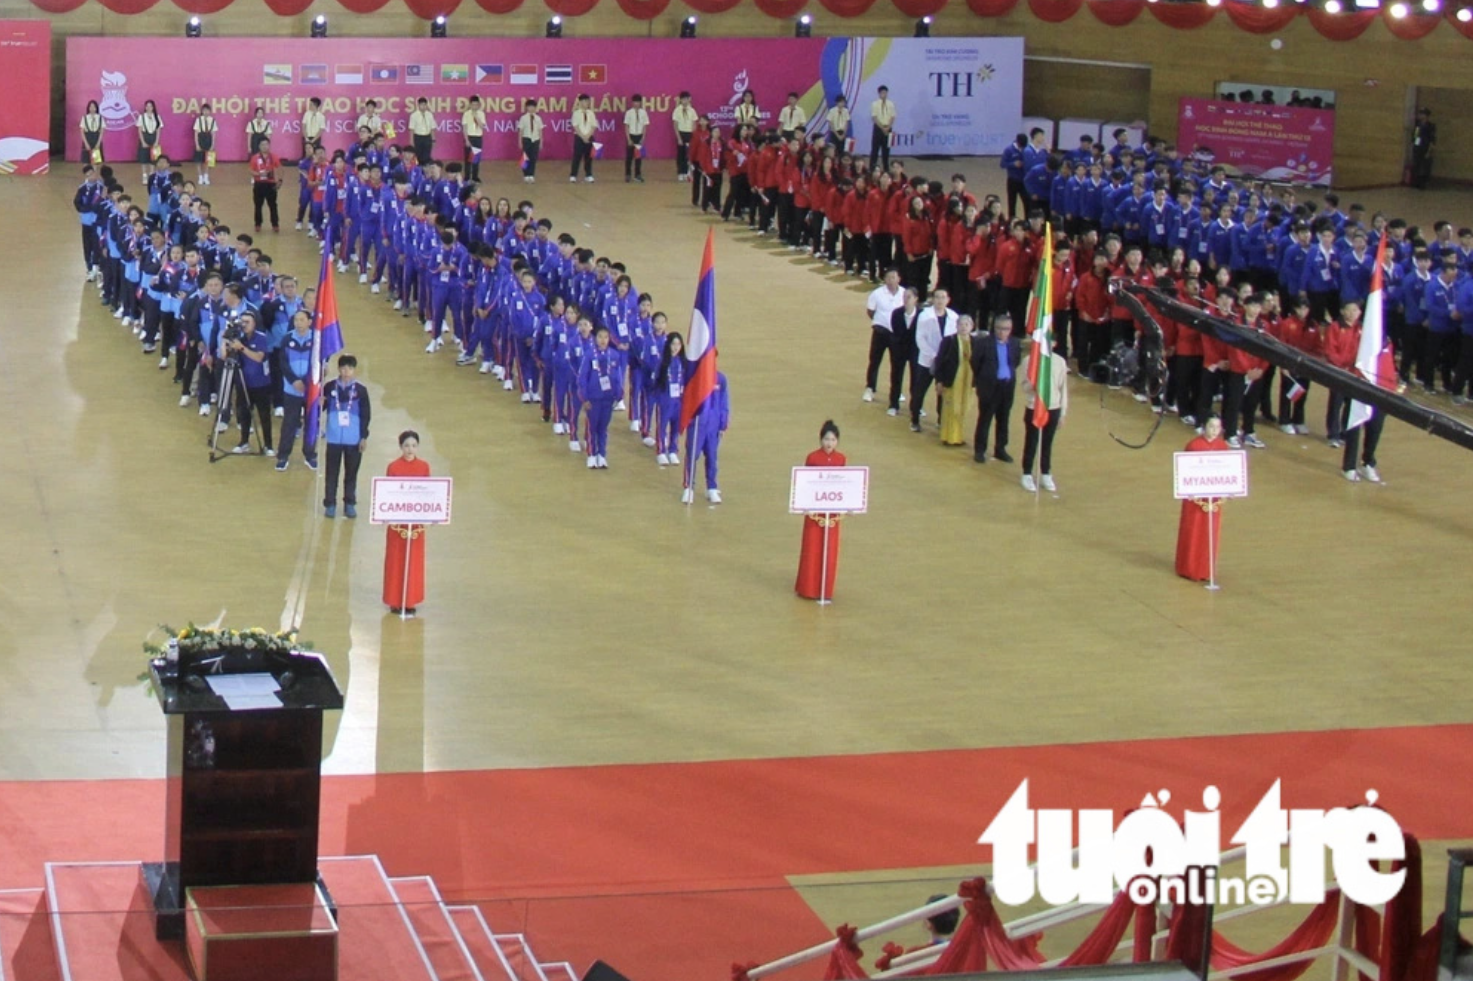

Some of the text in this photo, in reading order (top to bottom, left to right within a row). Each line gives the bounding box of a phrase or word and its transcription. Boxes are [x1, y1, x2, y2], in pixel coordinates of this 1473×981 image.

[929, 72, 975, 98] TH
[212, 94, 249, 118] HỘI
[641, 93, 672, 113] HỨ
[550, 119, 616, 133] VIEAM
[897, 133, 915, 147] TH
[1182, 475, 1238, 486] MYANMAR
[814, 491, 844, 502] LAOS
[378, 502, 443, 513] CAMBODIA
